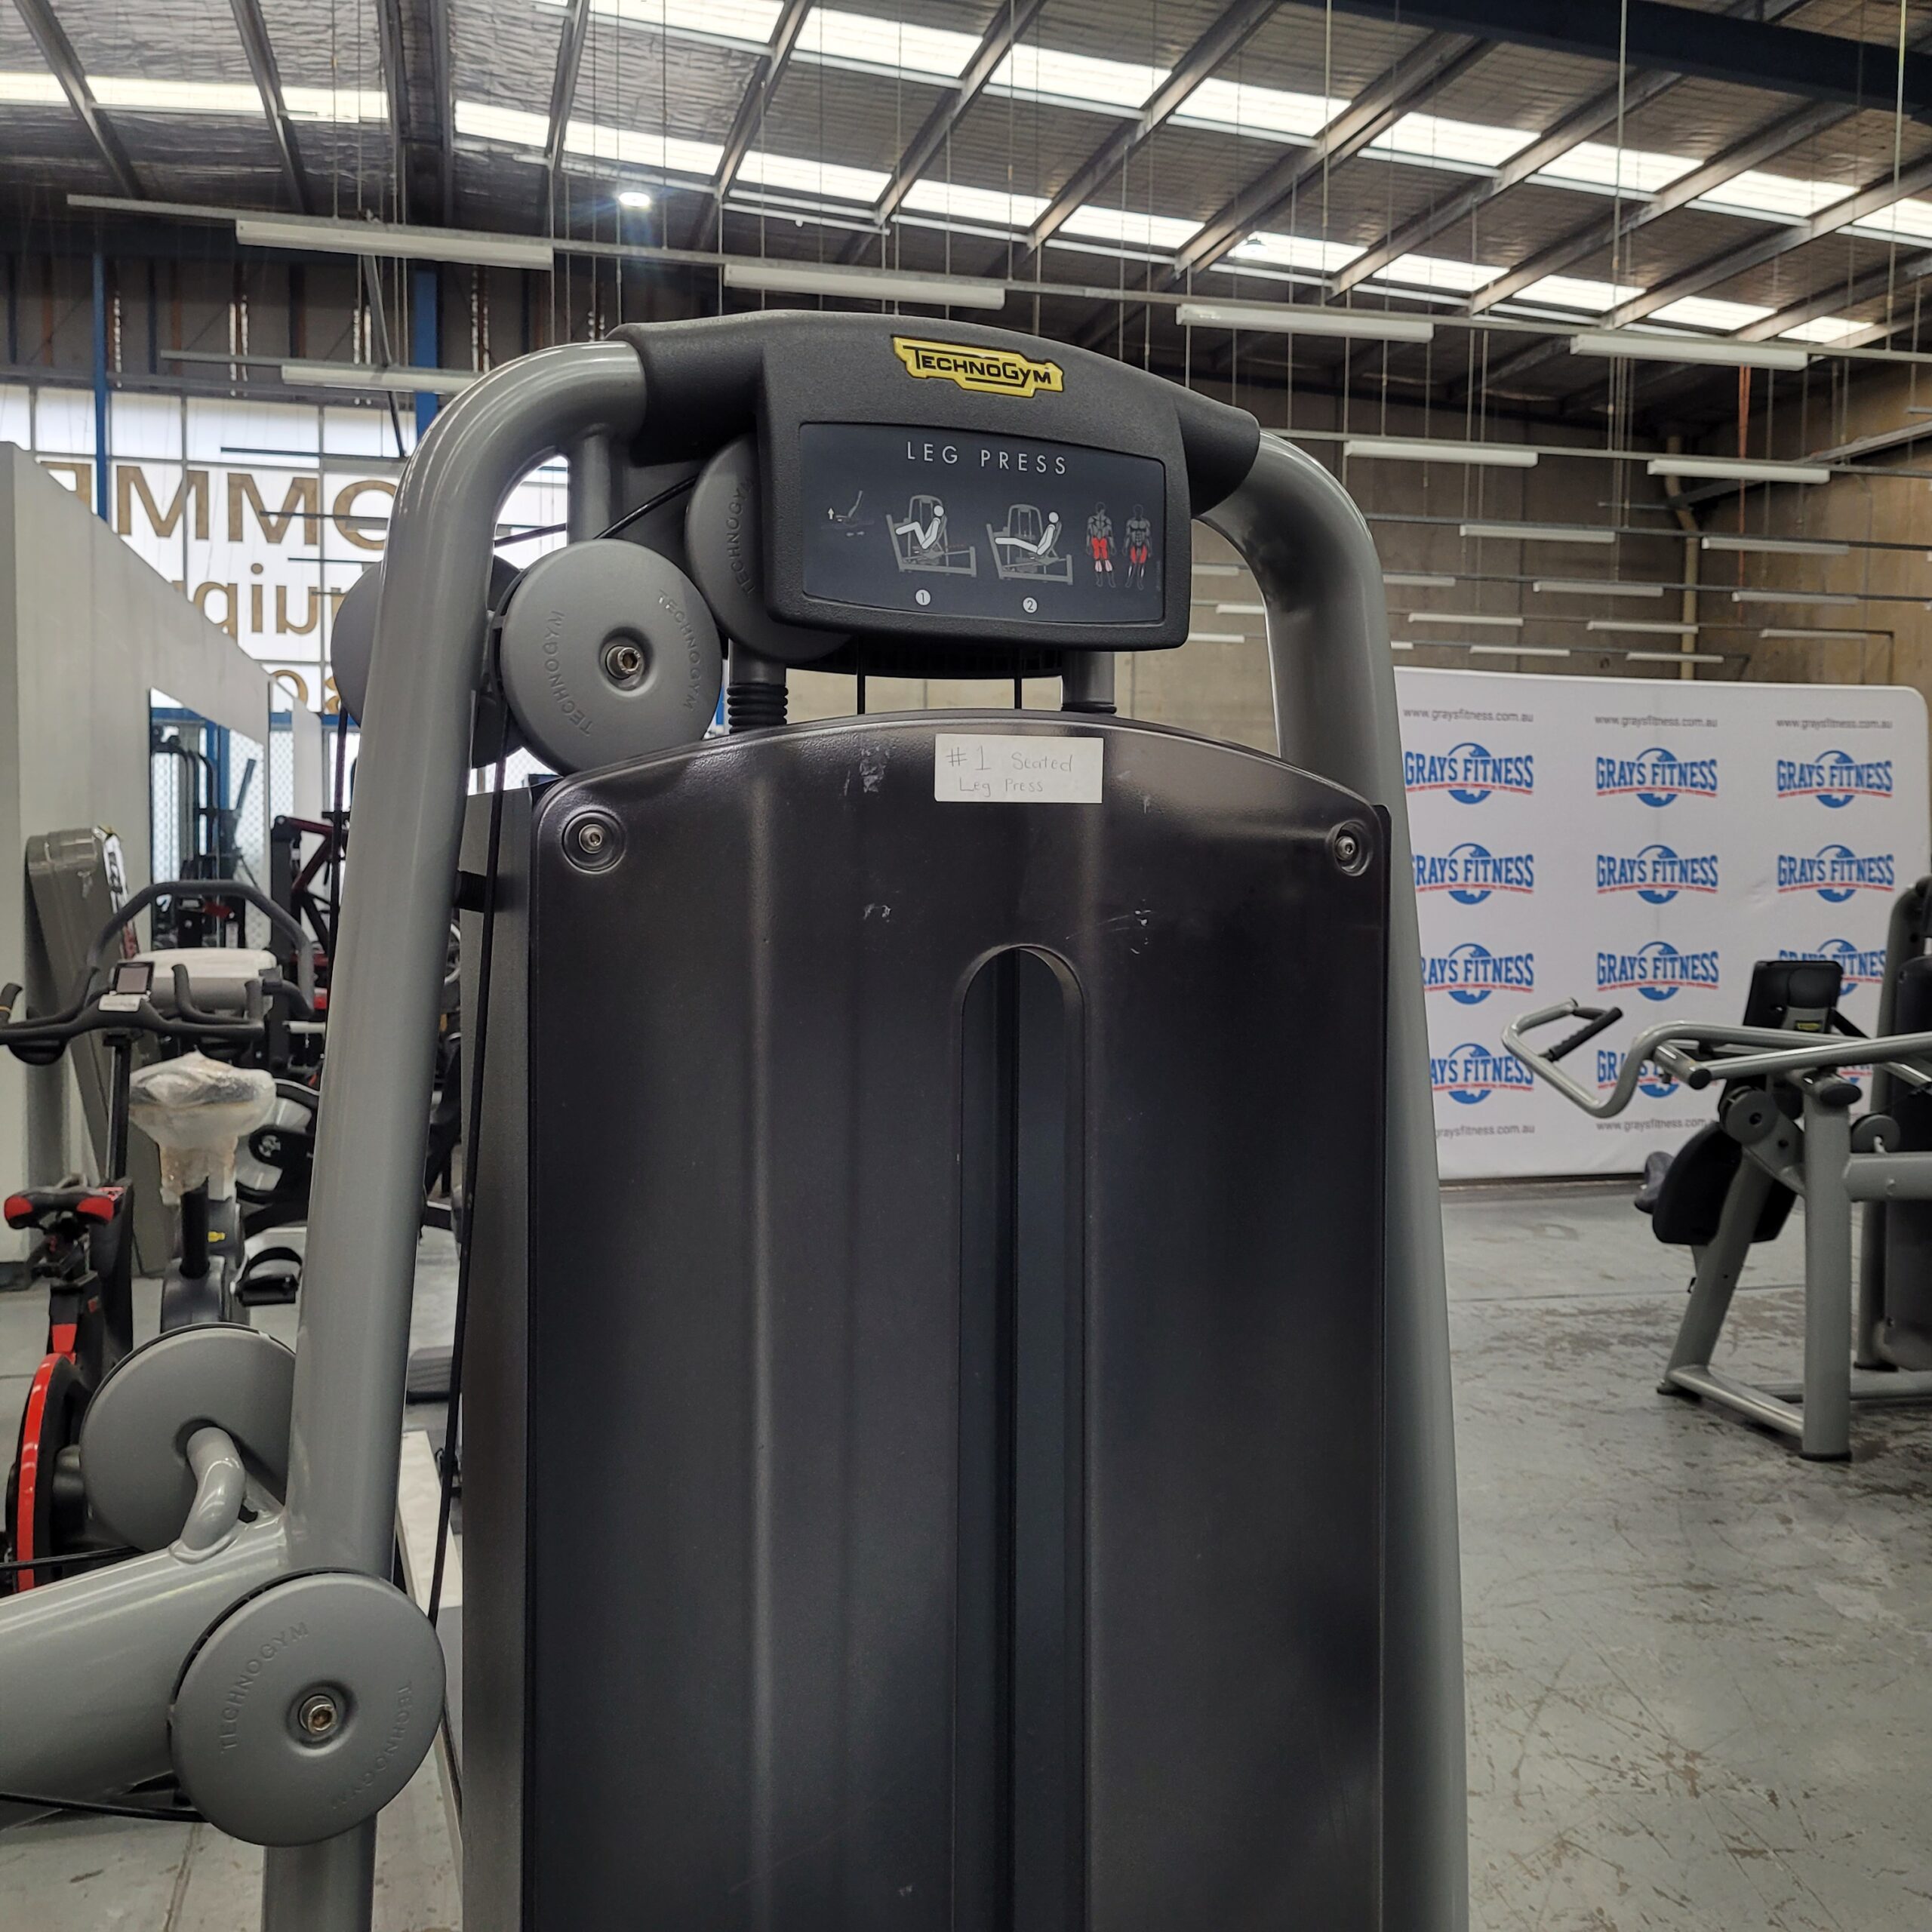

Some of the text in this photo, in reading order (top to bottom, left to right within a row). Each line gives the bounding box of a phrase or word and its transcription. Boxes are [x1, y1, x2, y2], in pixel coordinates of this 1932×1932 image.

[907, 441, 1066, 475] LEG PRESS
[657, 589, 701, 712] TECHNOGYM
[542, 610, 594, 737] TECHNOGYM
[1011, 752, 1073, 773] Seated
[1405, 752, 1534, 788] GRAYS FITNESS
[1596, 757, 1718, 791] GRAYS FITNESS
[1777, 759, 1893, 792] GRAYS FITNESS
[959, 777, 1044, 798] Leg Press
[1412, 854, 1534, 888] RAYS FITNESS
[1597, 854, 1718, 888] GRAYS FITNESS
[1777, 854, 1894, 886] GRAYS FITNESS
[1463, 953, 1534, 986] FITNESS
[1597, 951, 1719, 985] GRAYS FITNESS
[219, 1622, 309, 1755] TECHNOGYM
